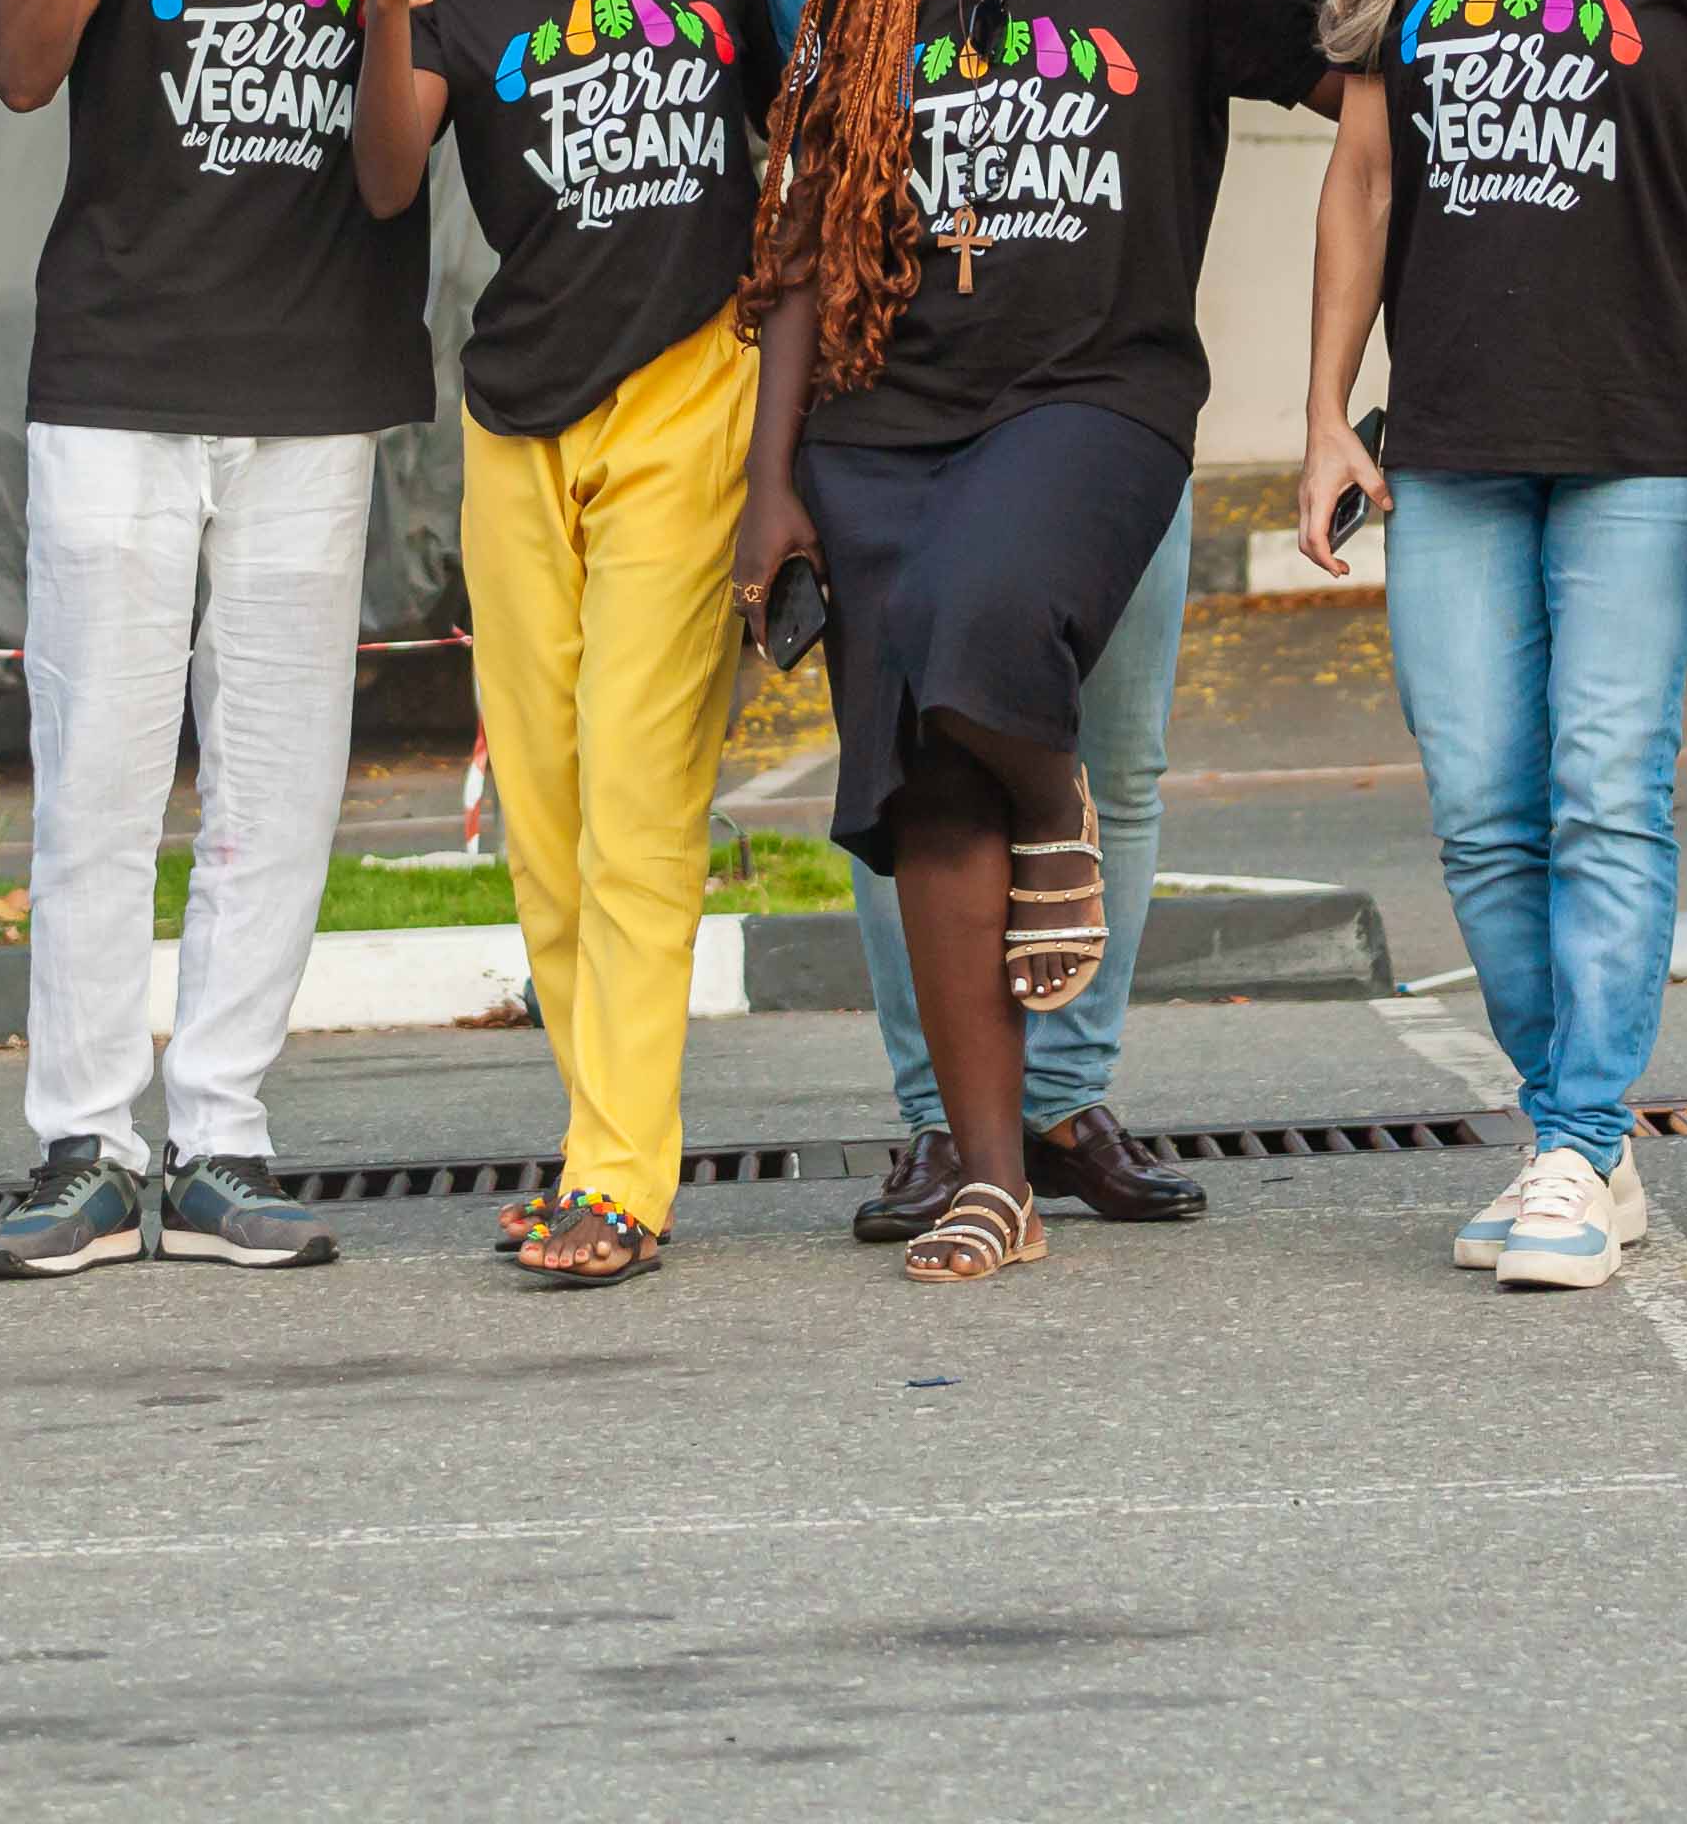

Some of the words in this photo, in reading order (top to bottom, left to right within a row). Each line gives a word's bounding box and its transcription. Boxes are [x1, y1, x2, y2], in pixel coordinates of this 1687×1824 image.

[182, 0, 356, 70] Feira
[1416, 29, 1608, 103] Feira
[160, 65, 354, 141] VEGANA
[529, 46, 721, 126] Feira
[913, 76, 1110, 148] Feira
[181, 122, 211, 147] de
[199, 123, 324, 176] Luanda
[522, 111, 725, 194] VEGANA
[1412, 101, 1617, 181] VEGANA
[556, 188, 582, 211] de
[1429, 162, 1451, 189] de
[1444, 161, 1580, 216] Luanda
[930, 210, 955, 233] de
[951, 198, 1087, 256] uanda
